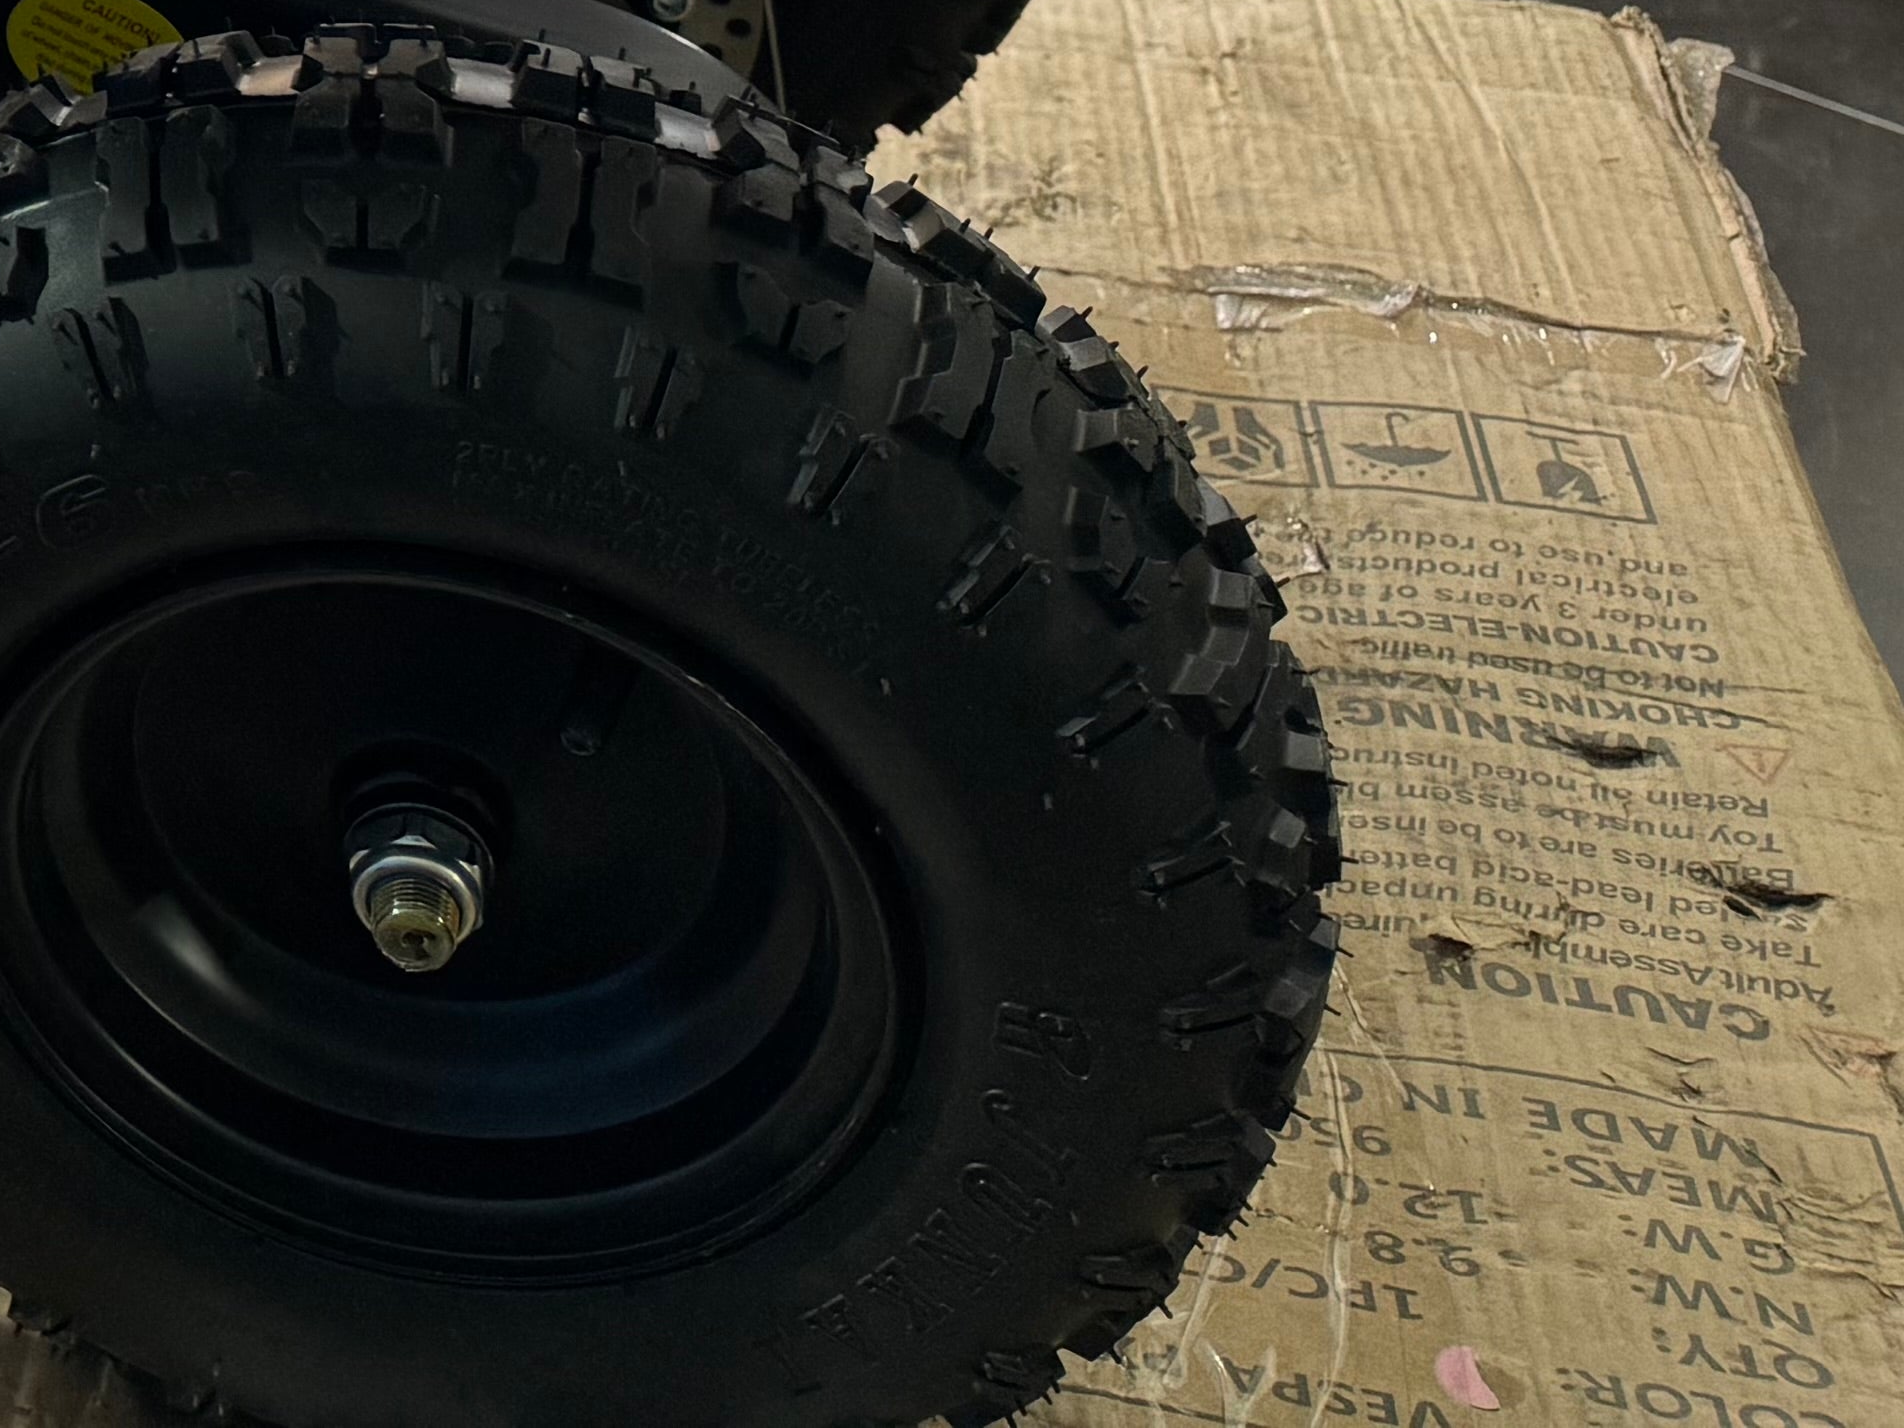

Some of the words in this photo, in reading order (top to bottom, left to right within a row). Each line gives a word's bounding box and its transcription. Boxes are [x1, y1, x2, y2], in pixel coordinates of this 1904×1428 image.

[1345, 527, 1475, 556] reduce
[1488, 538, 1525, 562] to
[1619, 556, 1689, 578] and
[1298, 575, 1367, 597] age
[1379, 584, 1420, 604] of
[1432, 584, 1542, 614] years
[1515, 568, 1700, 609] electrical
[1558, 601, 1577, 621] 3
[1593, 607, 1708, 636] under
[1295, 604, 1720, 665] CAUTION-ELECTRIC
[1467, 651, 1554, 680] used
[1562, 662, 1606, 690] be
[1616, 669, 1654, 691] to
[1660, 673, 1725, 700] Not
[1515, 687, 1742, 731] CHOKING
[1333, 698, 1681, 770] WARNING
[1472, 761, 1577, 794] noted
[1536, 804, 1584, 828] be
[1646, 791, 1770, 818] Retain
[1437, 820, 1482, 847] be
[1493, 827, 1530, 850] to
[1593, 812, 1694, 843] must
[1708, 825, 1785, 854] Toy
[1540, 836, 1597, 858] are
[1473, 859, 1654, 914] lead-acid
[1473, 886, 1606, 935] during
[1618, 919, 1706, 946] care
[1719, 933, 1822, 968] Take
[1409, 938, 1771, 1041] CAUTION
[1718, 968, 1834, 1011] Adult
[1401, 1081, 1486, 1120] IN
[1521, 1097, 1761, 1168] MADE
[1542, 1148, 1778, 1224] MEAS:
[1652, 1327, 1835, 1390] QTY:
